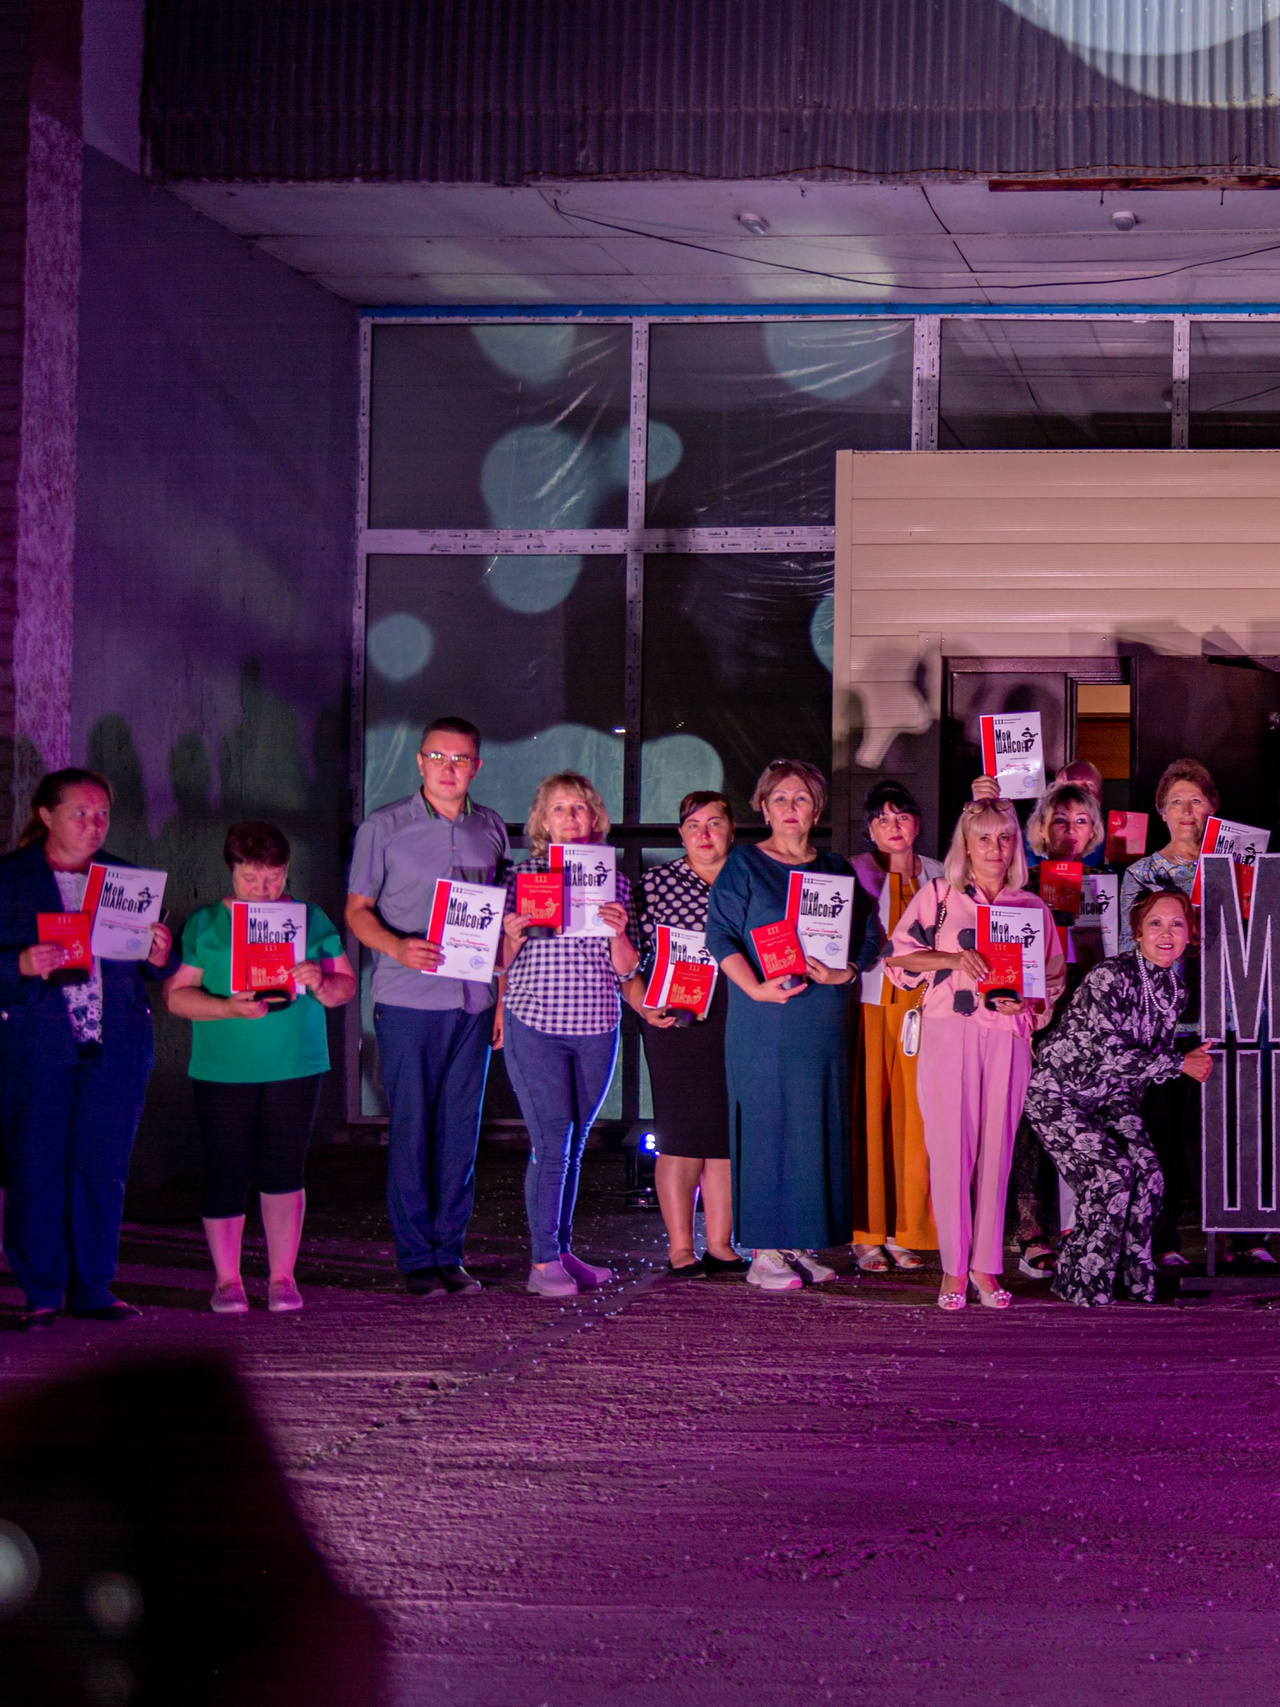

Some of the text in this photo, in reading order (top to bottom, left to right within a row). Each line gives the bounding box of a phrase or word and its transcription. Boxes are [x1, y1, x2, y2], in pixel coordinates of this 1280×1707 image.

[564, 860, 582, 873] Мой
[802, 888, 819, 902] Мой
[450, 897, 468, 912] Мой
[991, 921, 1009, 935] Мой
[671, 941, 687, 953] Мой
